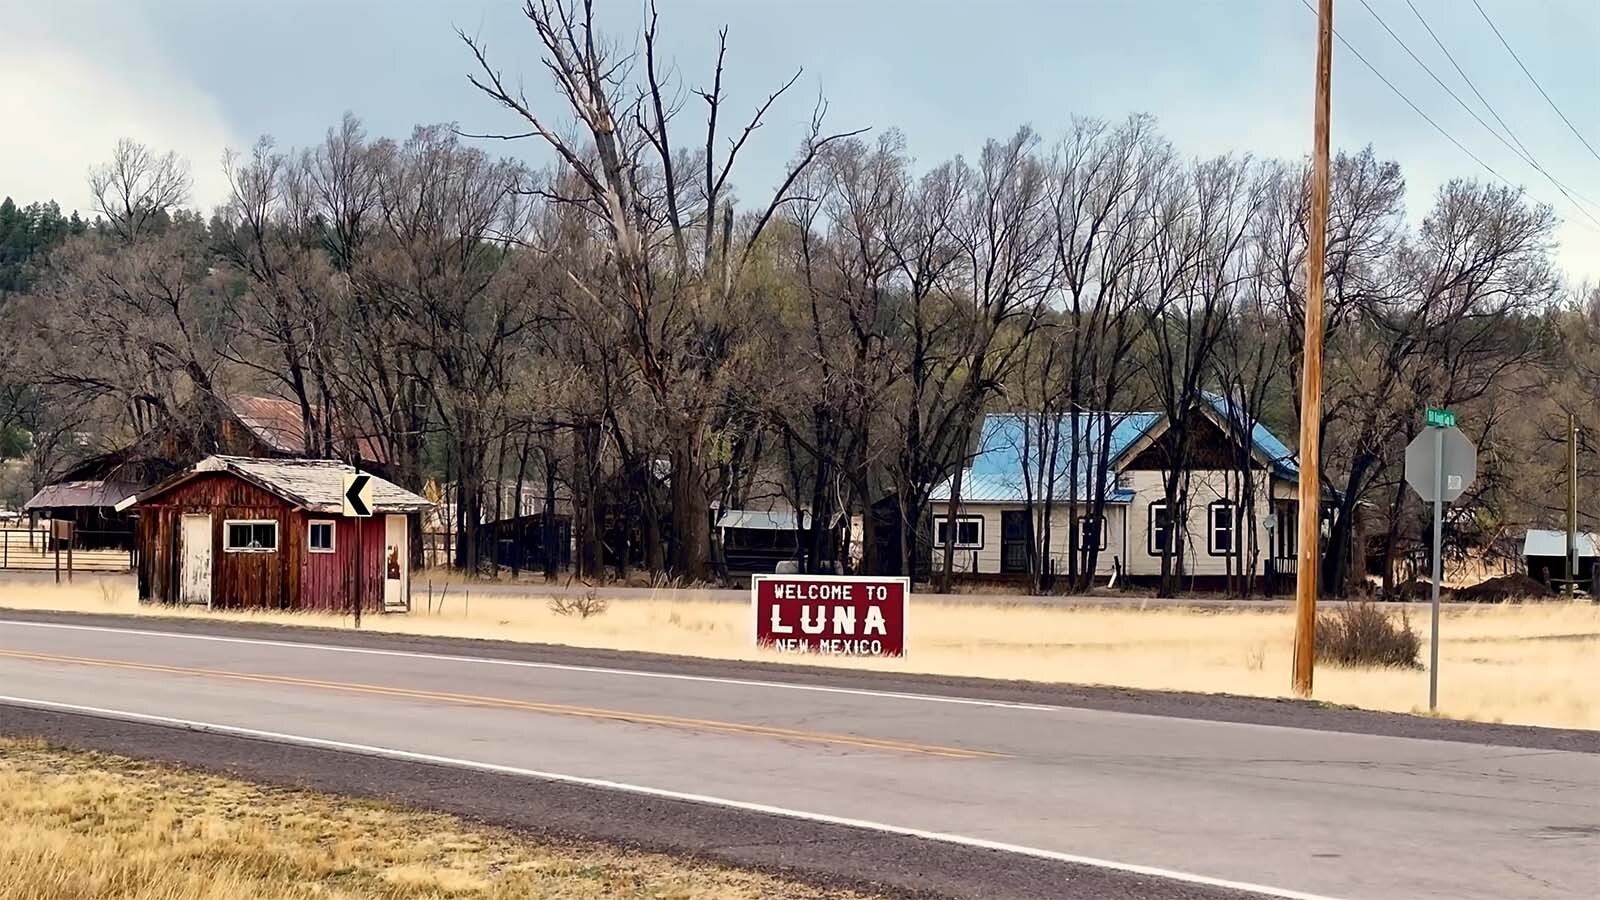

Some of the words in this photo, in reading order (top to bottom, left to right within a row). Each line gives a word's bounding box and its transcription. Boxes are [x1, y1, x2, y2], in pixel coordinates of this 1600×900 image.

[774, 584, 853, 600] WELCOME
[866, 585, 888, 601] TO
[770, 604, 887, 635] LUNA
[775, 638, 809, 654] NEW
[819, 638, 882, 655] MEXICO
